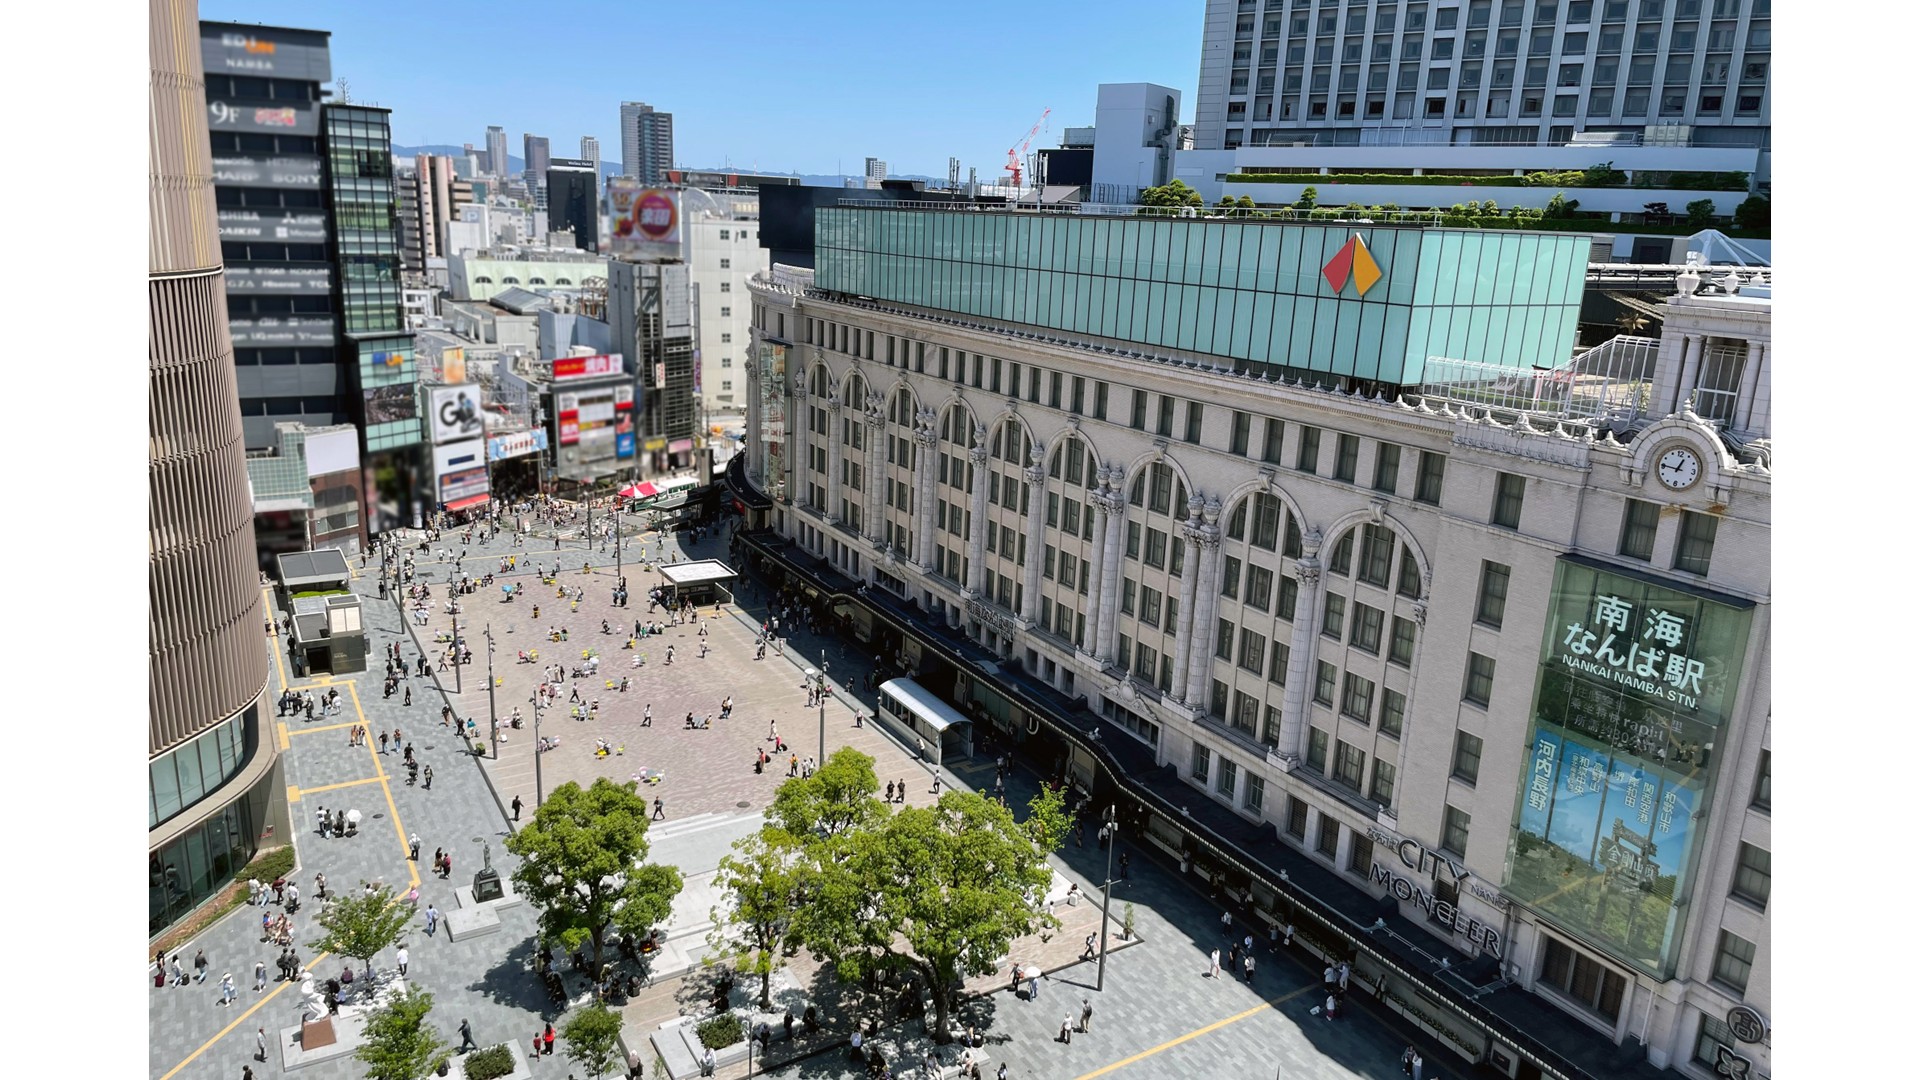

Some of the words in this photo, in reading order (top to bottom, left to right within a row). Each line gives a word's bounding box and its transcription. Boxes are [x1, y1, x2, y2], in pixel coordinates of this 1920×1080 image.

[225, 58, 274, 70] NAMBA
[210, 101, 240, 124] 9F
[213, 171, 260, 181] HARP
[272, 174, 321, 184] SONY
[262, 280, 301, 288] Hisense
[309, 281, 332, 289] TCL
[1595, 595, 1685, 648] 南海
[1563, 622, 1706, 695] なんば駅
[1562, 654, 1610, 679] NANKAI
[1614, 671, 1664, 698] NAMBA
[1667, 690, 1700, 710] STN.
[1528, 739, 1557, 811] 河内長野
[1574, 756, 1591, 797] 和泉中央
[1624, 775, 1640, 808] 岸和田
[1637, 782, 1655, 825] 関西空港
[1657, 792, 1677, 833] 和歌山市
[1398, 839, 1471, 894] CITY
[1369, 863, 1501, 958] MONCLER
